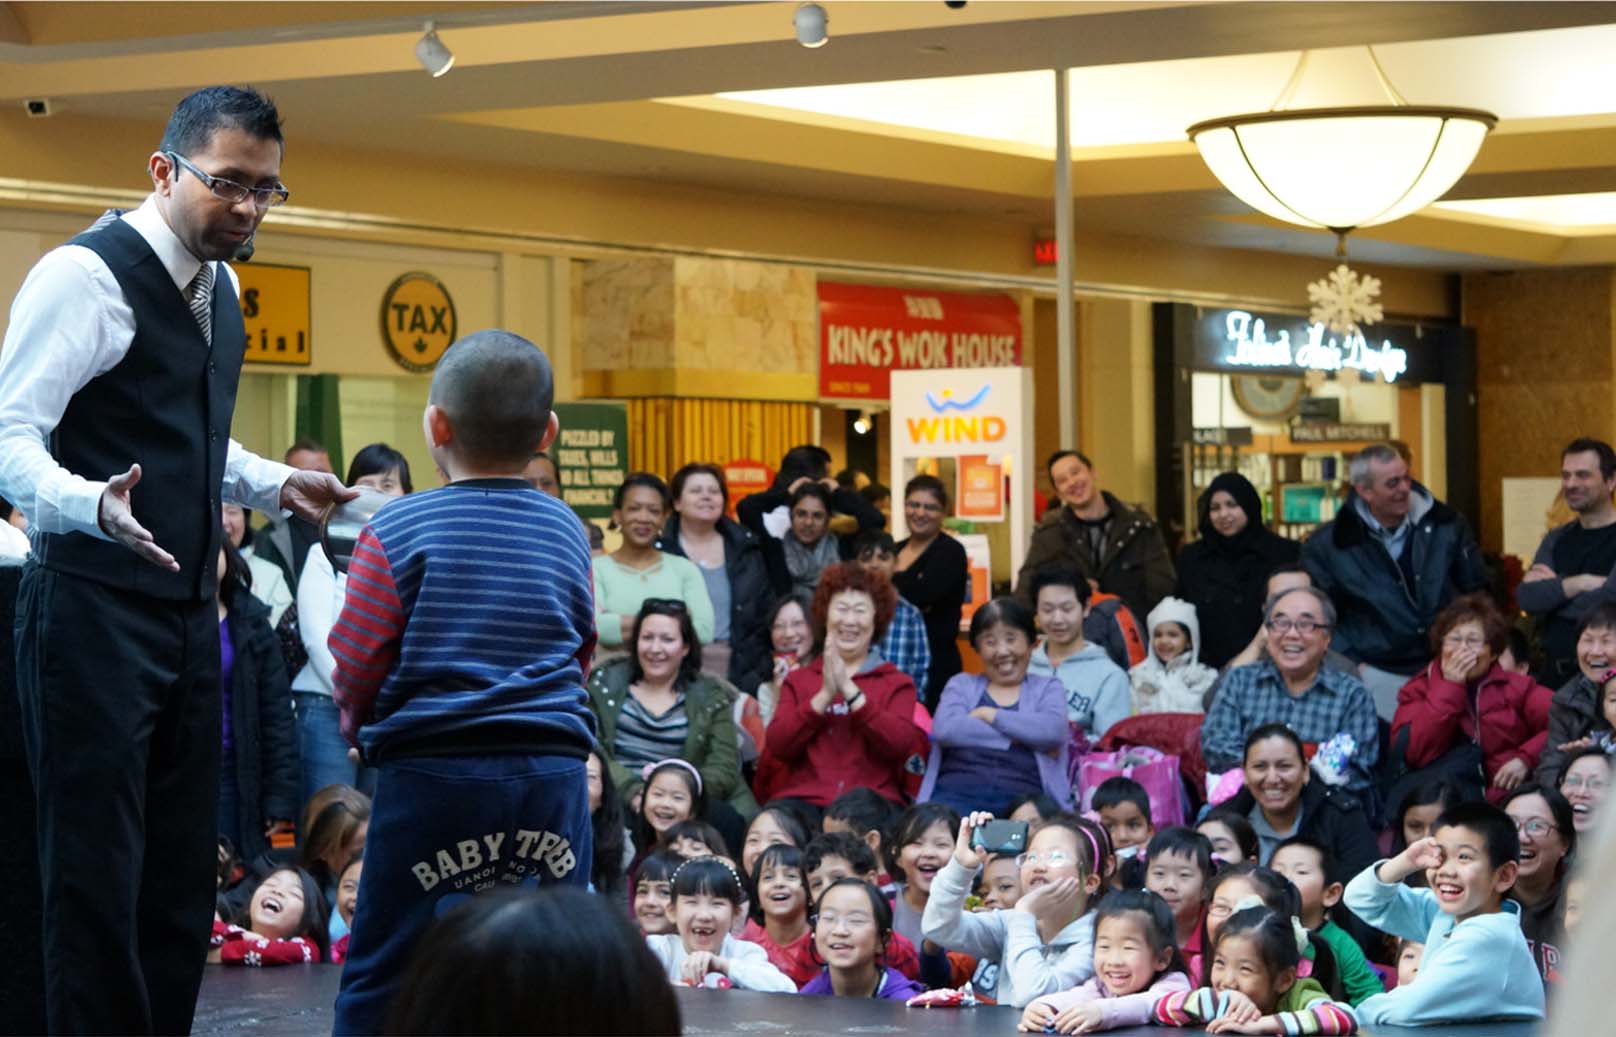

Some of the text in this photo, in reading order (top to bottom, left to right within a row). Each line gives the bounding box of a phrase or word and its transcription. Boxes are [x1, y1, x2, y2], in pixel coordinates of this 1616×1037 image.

[392, 303, 448, 335] TAX
[827, 324, 1016, 369] KING'S WOK HOUSE
[906, 415, 1007, 444] WIND
[411, 832, 505, 891] BABY
